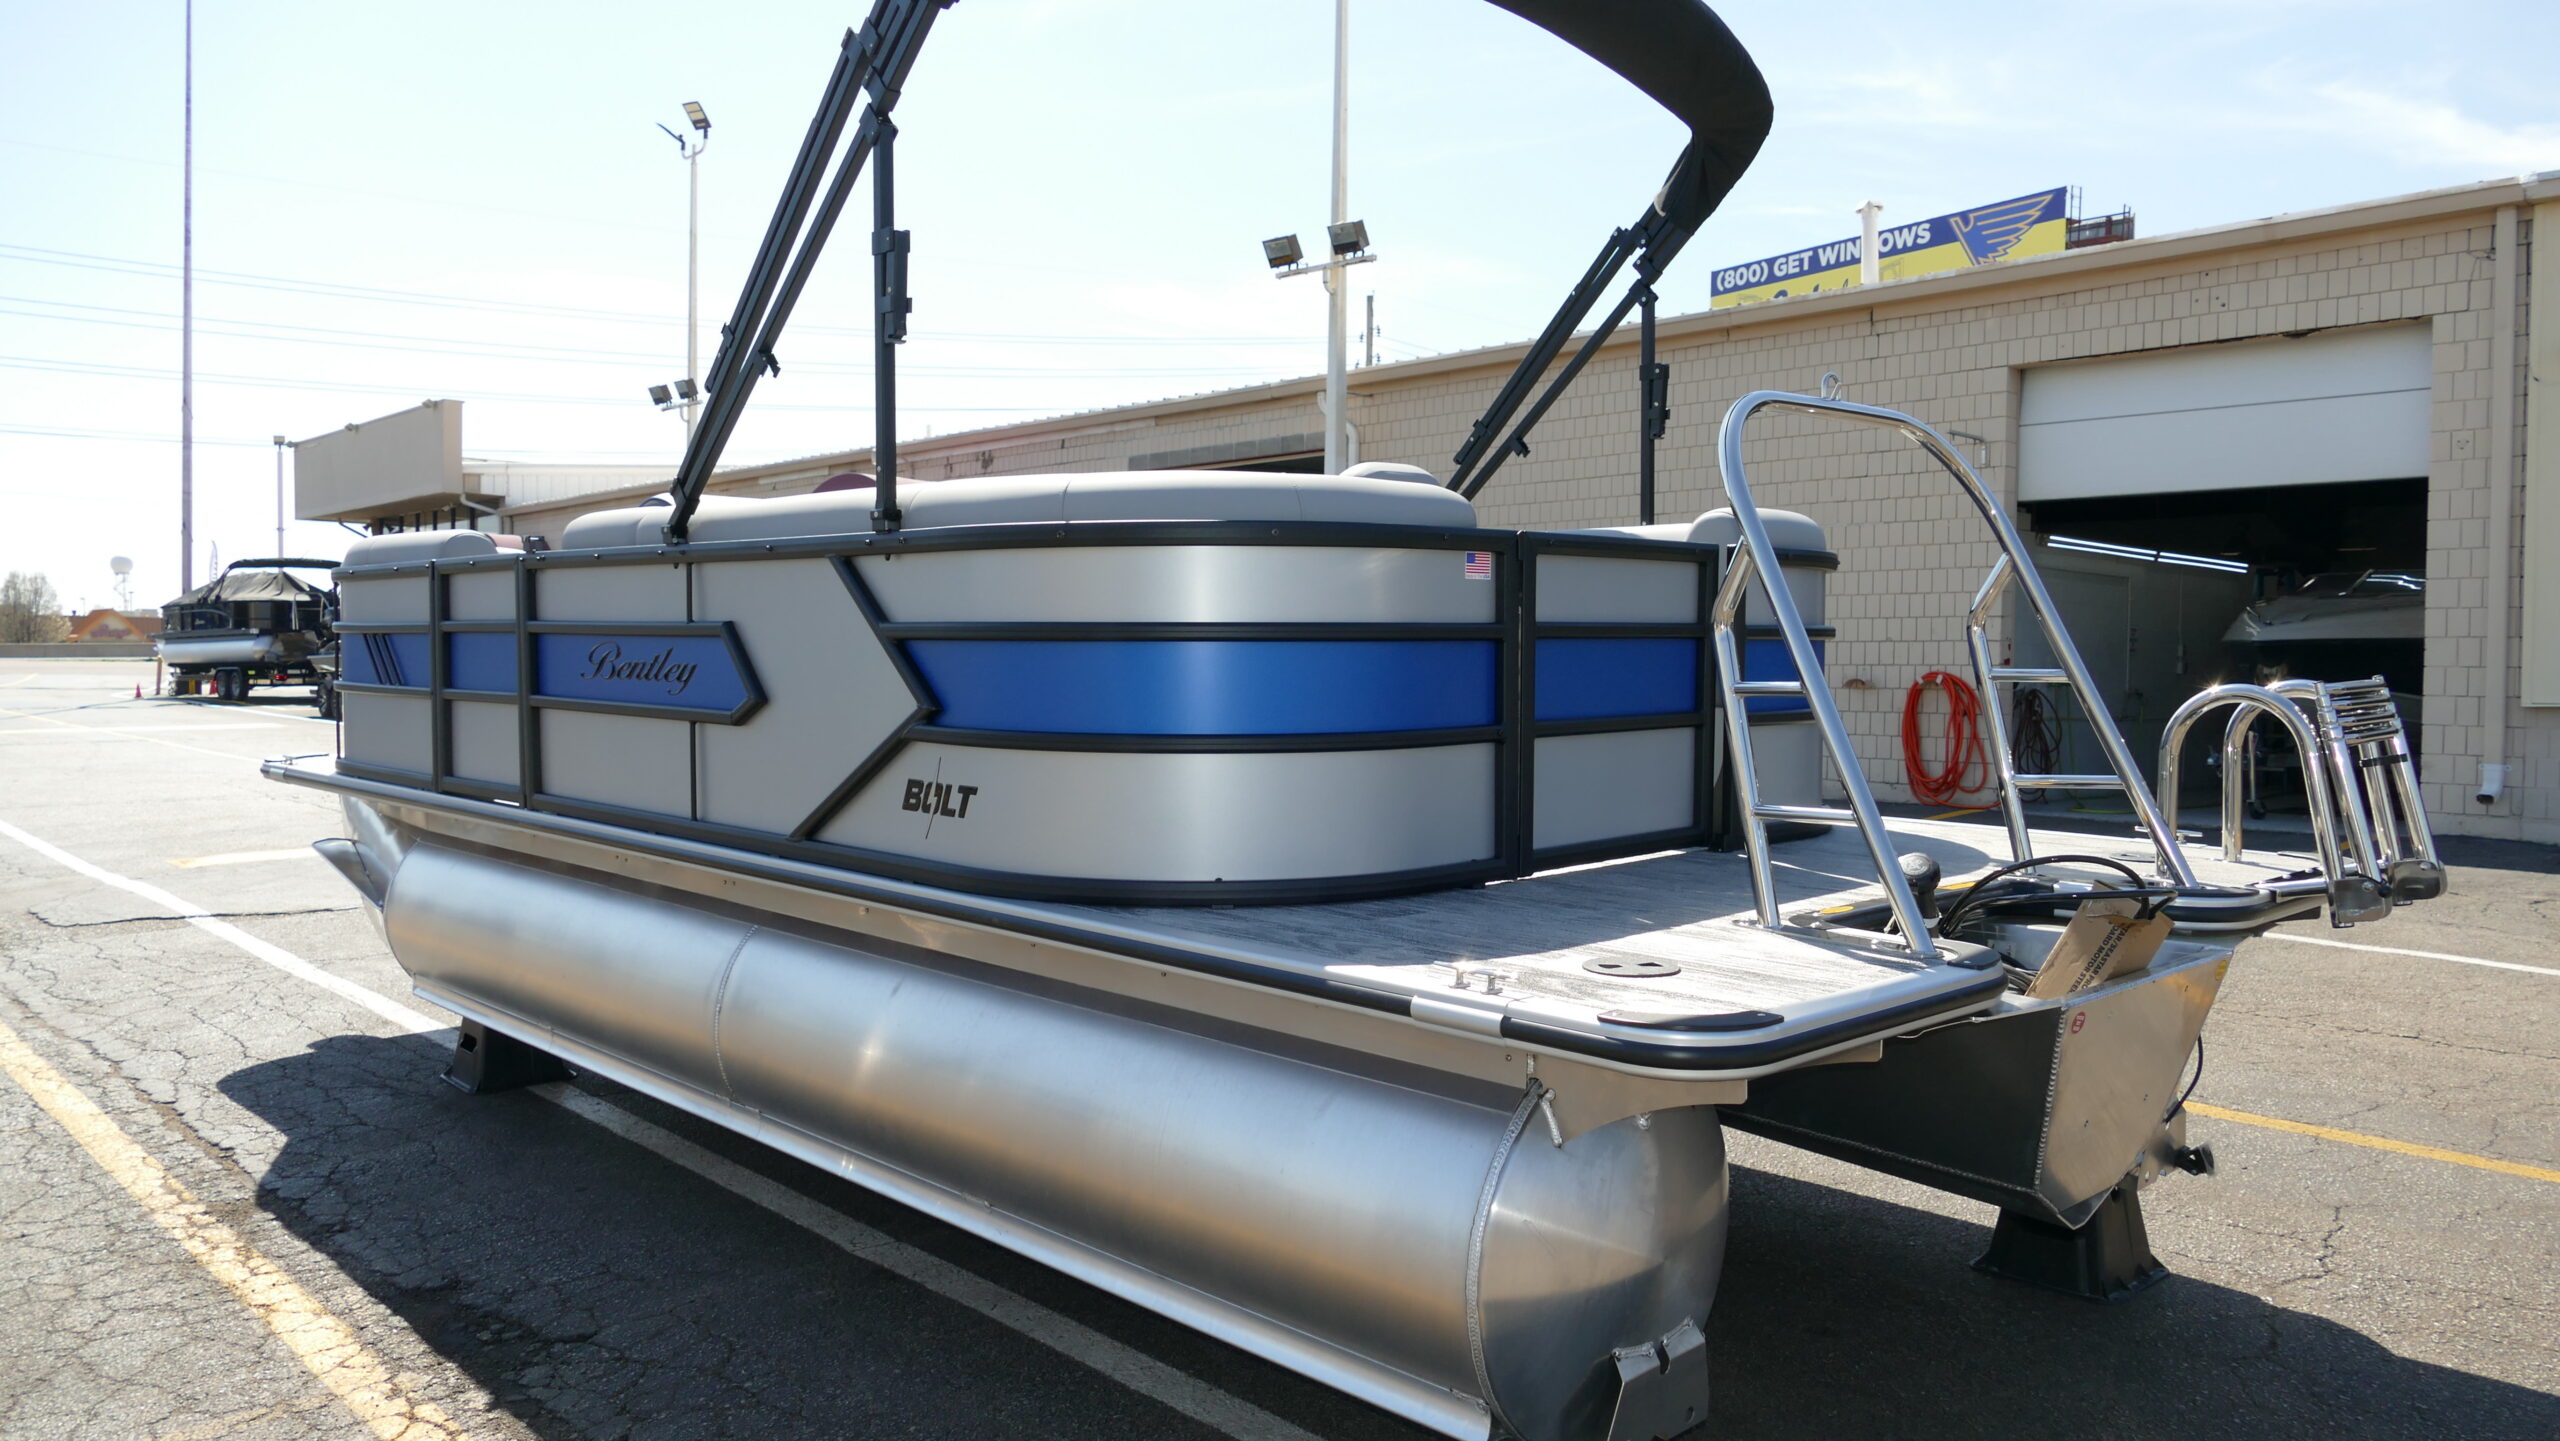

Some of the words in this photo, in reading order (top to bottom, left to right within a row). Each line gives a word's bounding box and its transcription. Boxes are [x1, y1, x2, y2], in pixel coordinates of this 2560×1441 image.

[1716, 261, 1768, 291] (800)
[1773, 250, 1813, 277] GET
[1818, 223, 1931, 267] WINOWS
[581, 641, 698, 696] Bentley
[902, 778, 978, 818] BOLT
[2084, 945, 2105, 973] MOTOR
